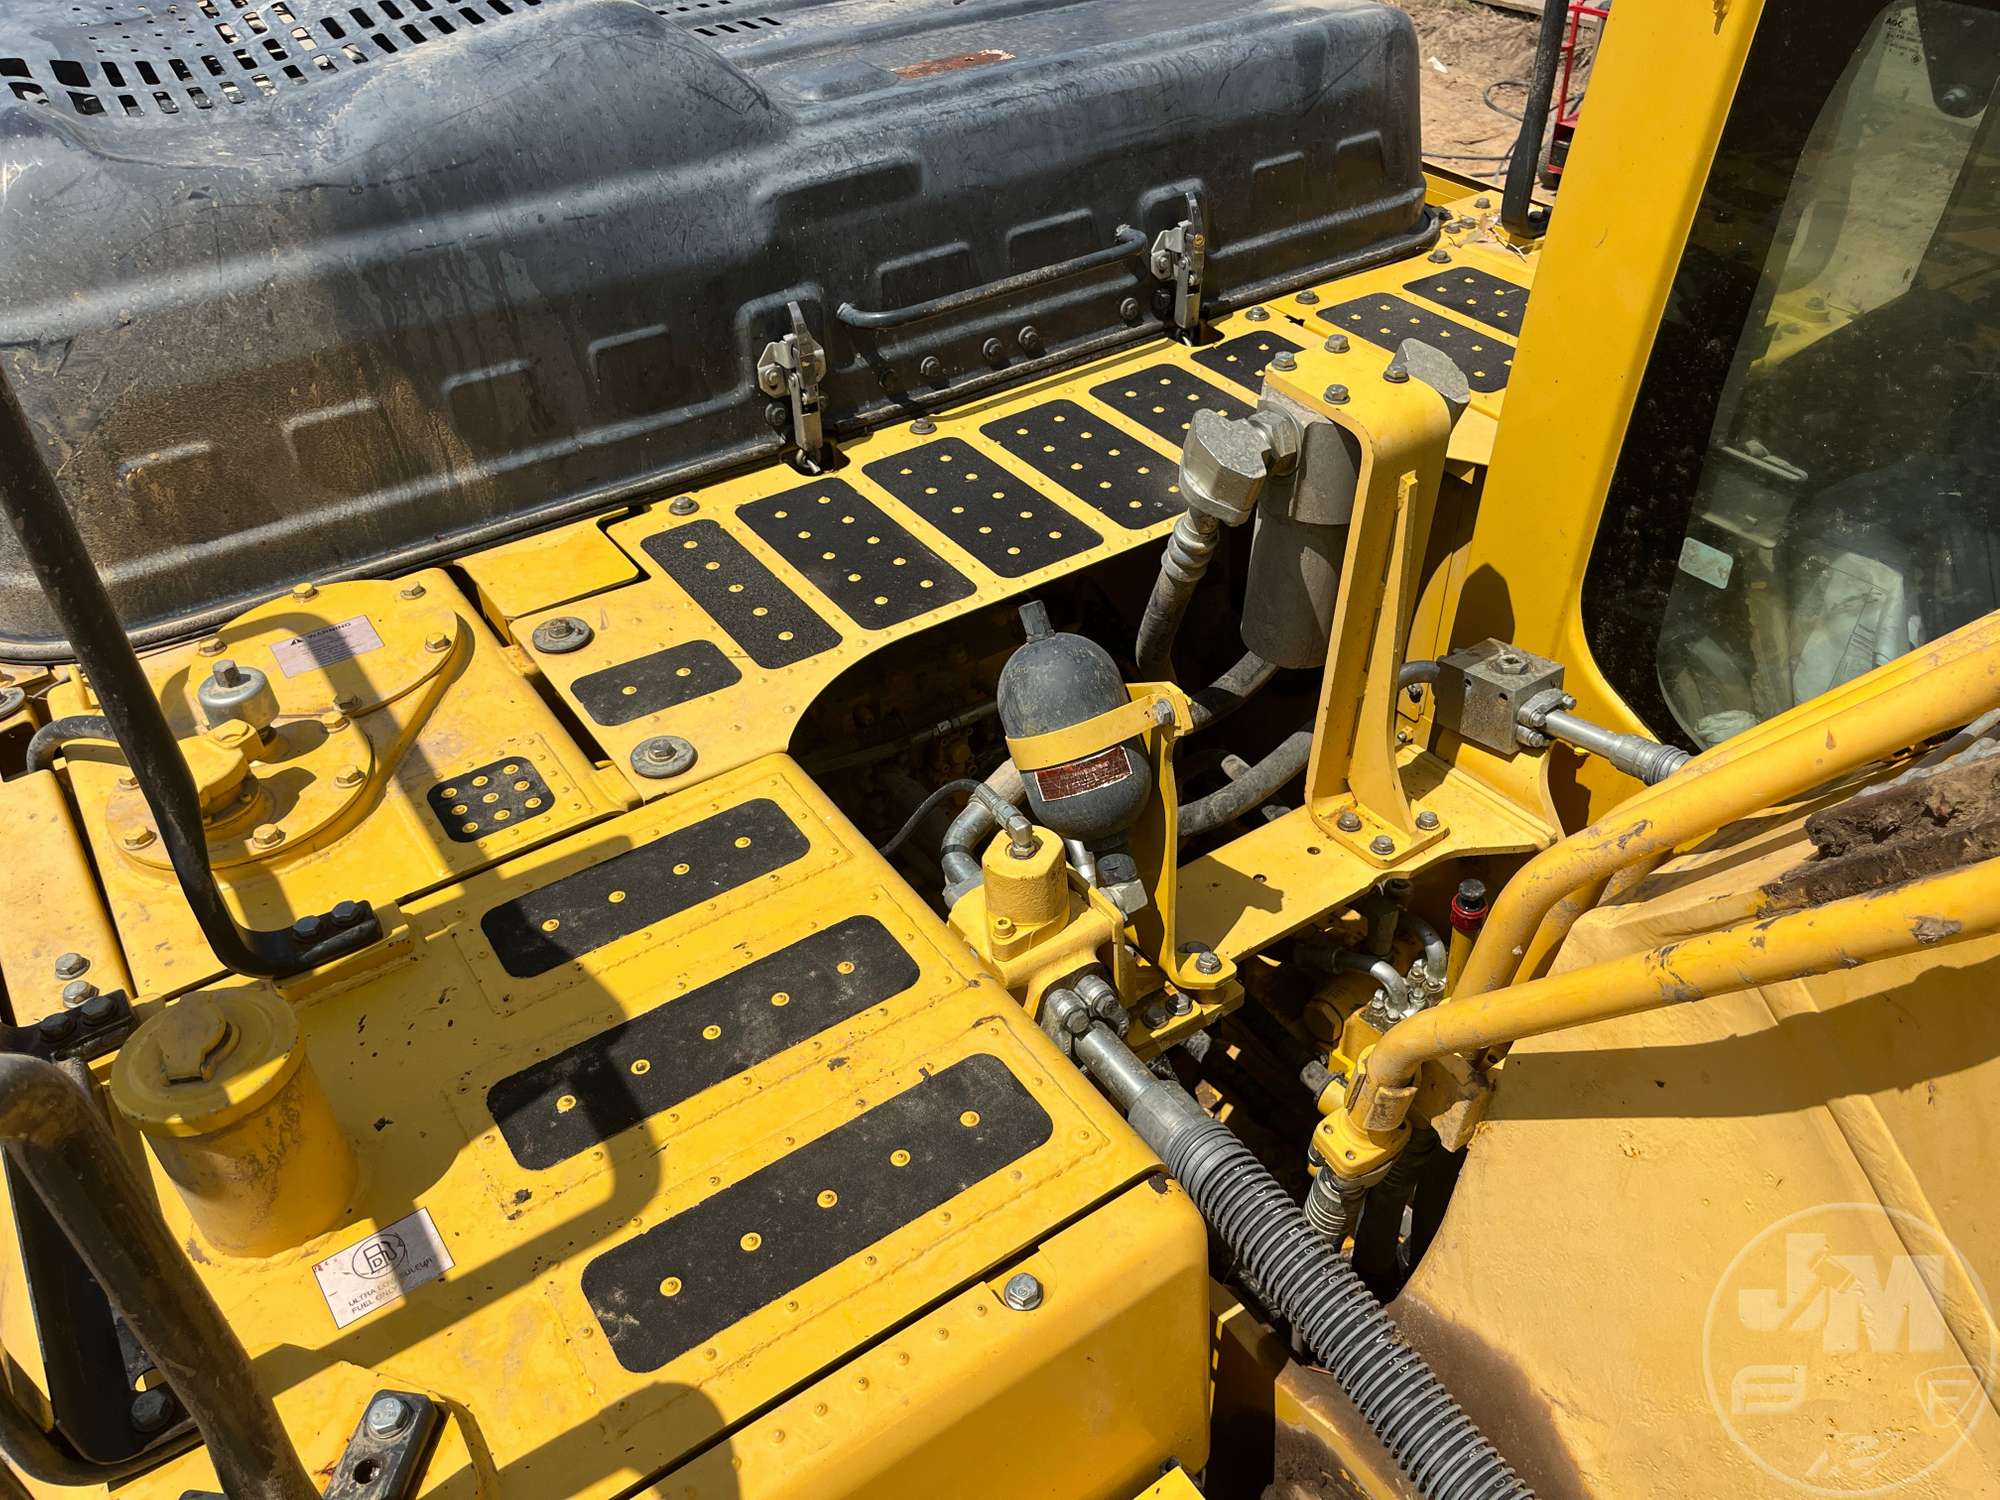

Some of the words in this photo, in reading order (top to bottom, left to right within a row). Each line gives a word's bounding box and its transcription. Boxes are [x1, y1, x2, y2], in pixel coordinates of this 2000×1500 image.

[307, 622, 352, 639] WARNING
[348, 1288, 377, 1308] ULTRA
[351, 1301, 375, 1315] FUEL
